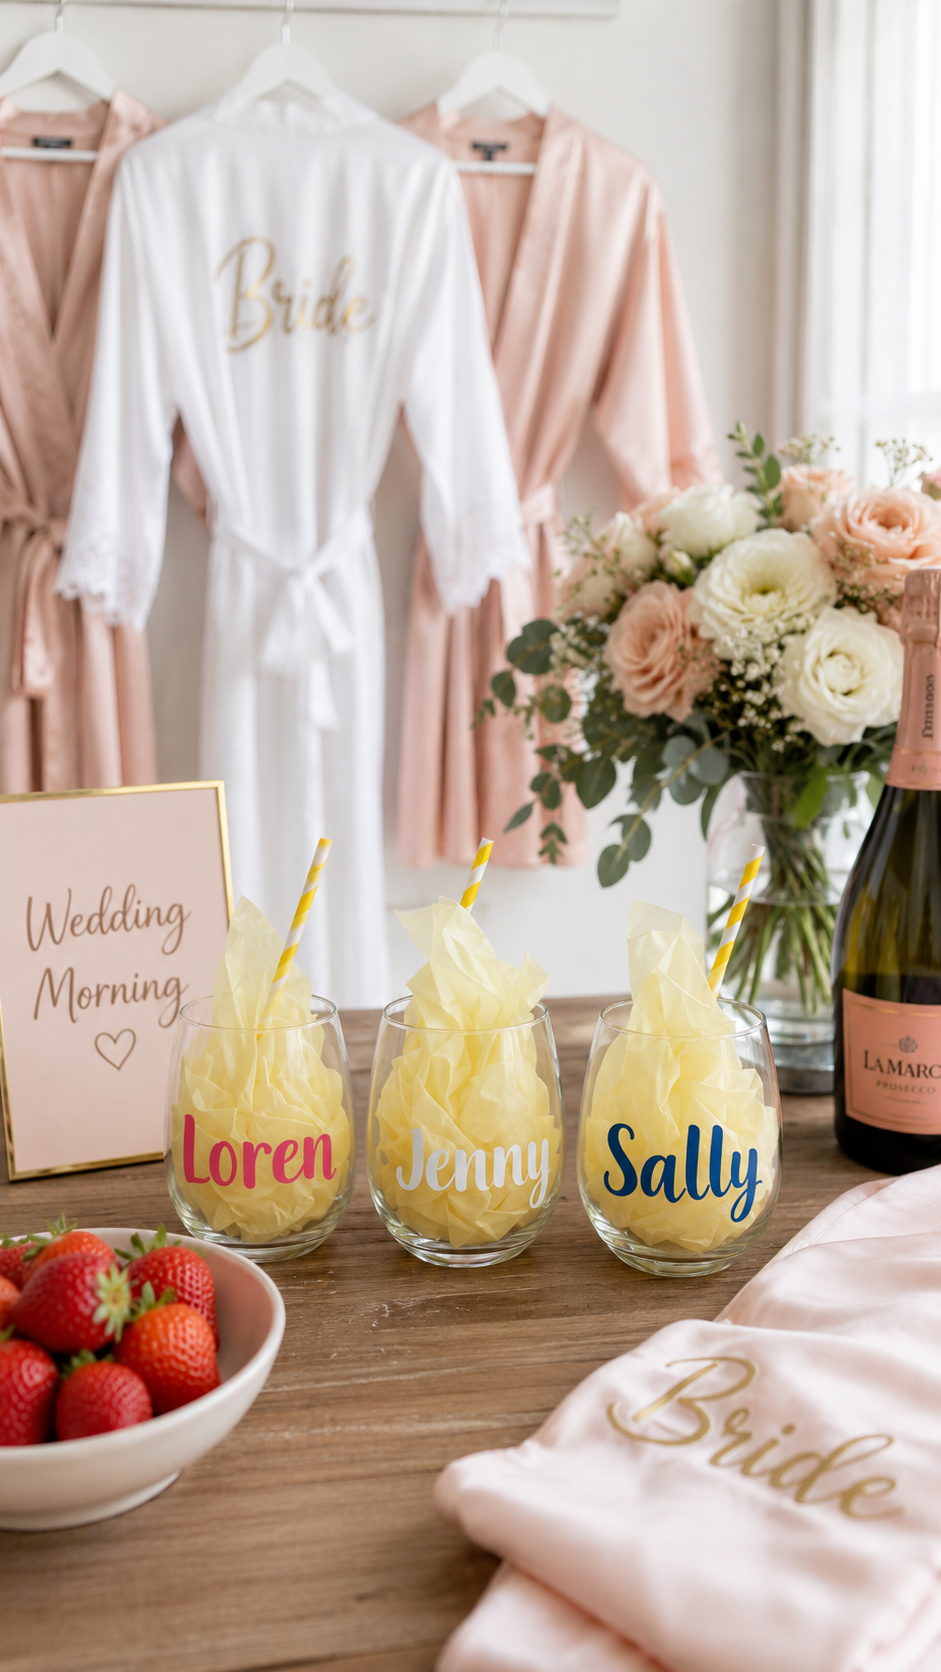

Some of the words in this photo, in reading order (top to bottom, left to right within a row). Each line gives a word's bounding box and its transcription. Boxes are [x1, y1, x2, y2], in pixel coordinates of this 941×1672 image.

[214, 236, 379, 354] Bride
[26, 883, 193, 956] Wedding
[33, 966, 190, 1029] Morning
[875, 1080, 937, 1094] PROSECCO
[182, 1114, 337, 1189] Loren
[395, 1127, 551, 1210] Jenny
[603, 1123, 764, 1223] Sally
[606, 1356, 905, 1521] Bride
